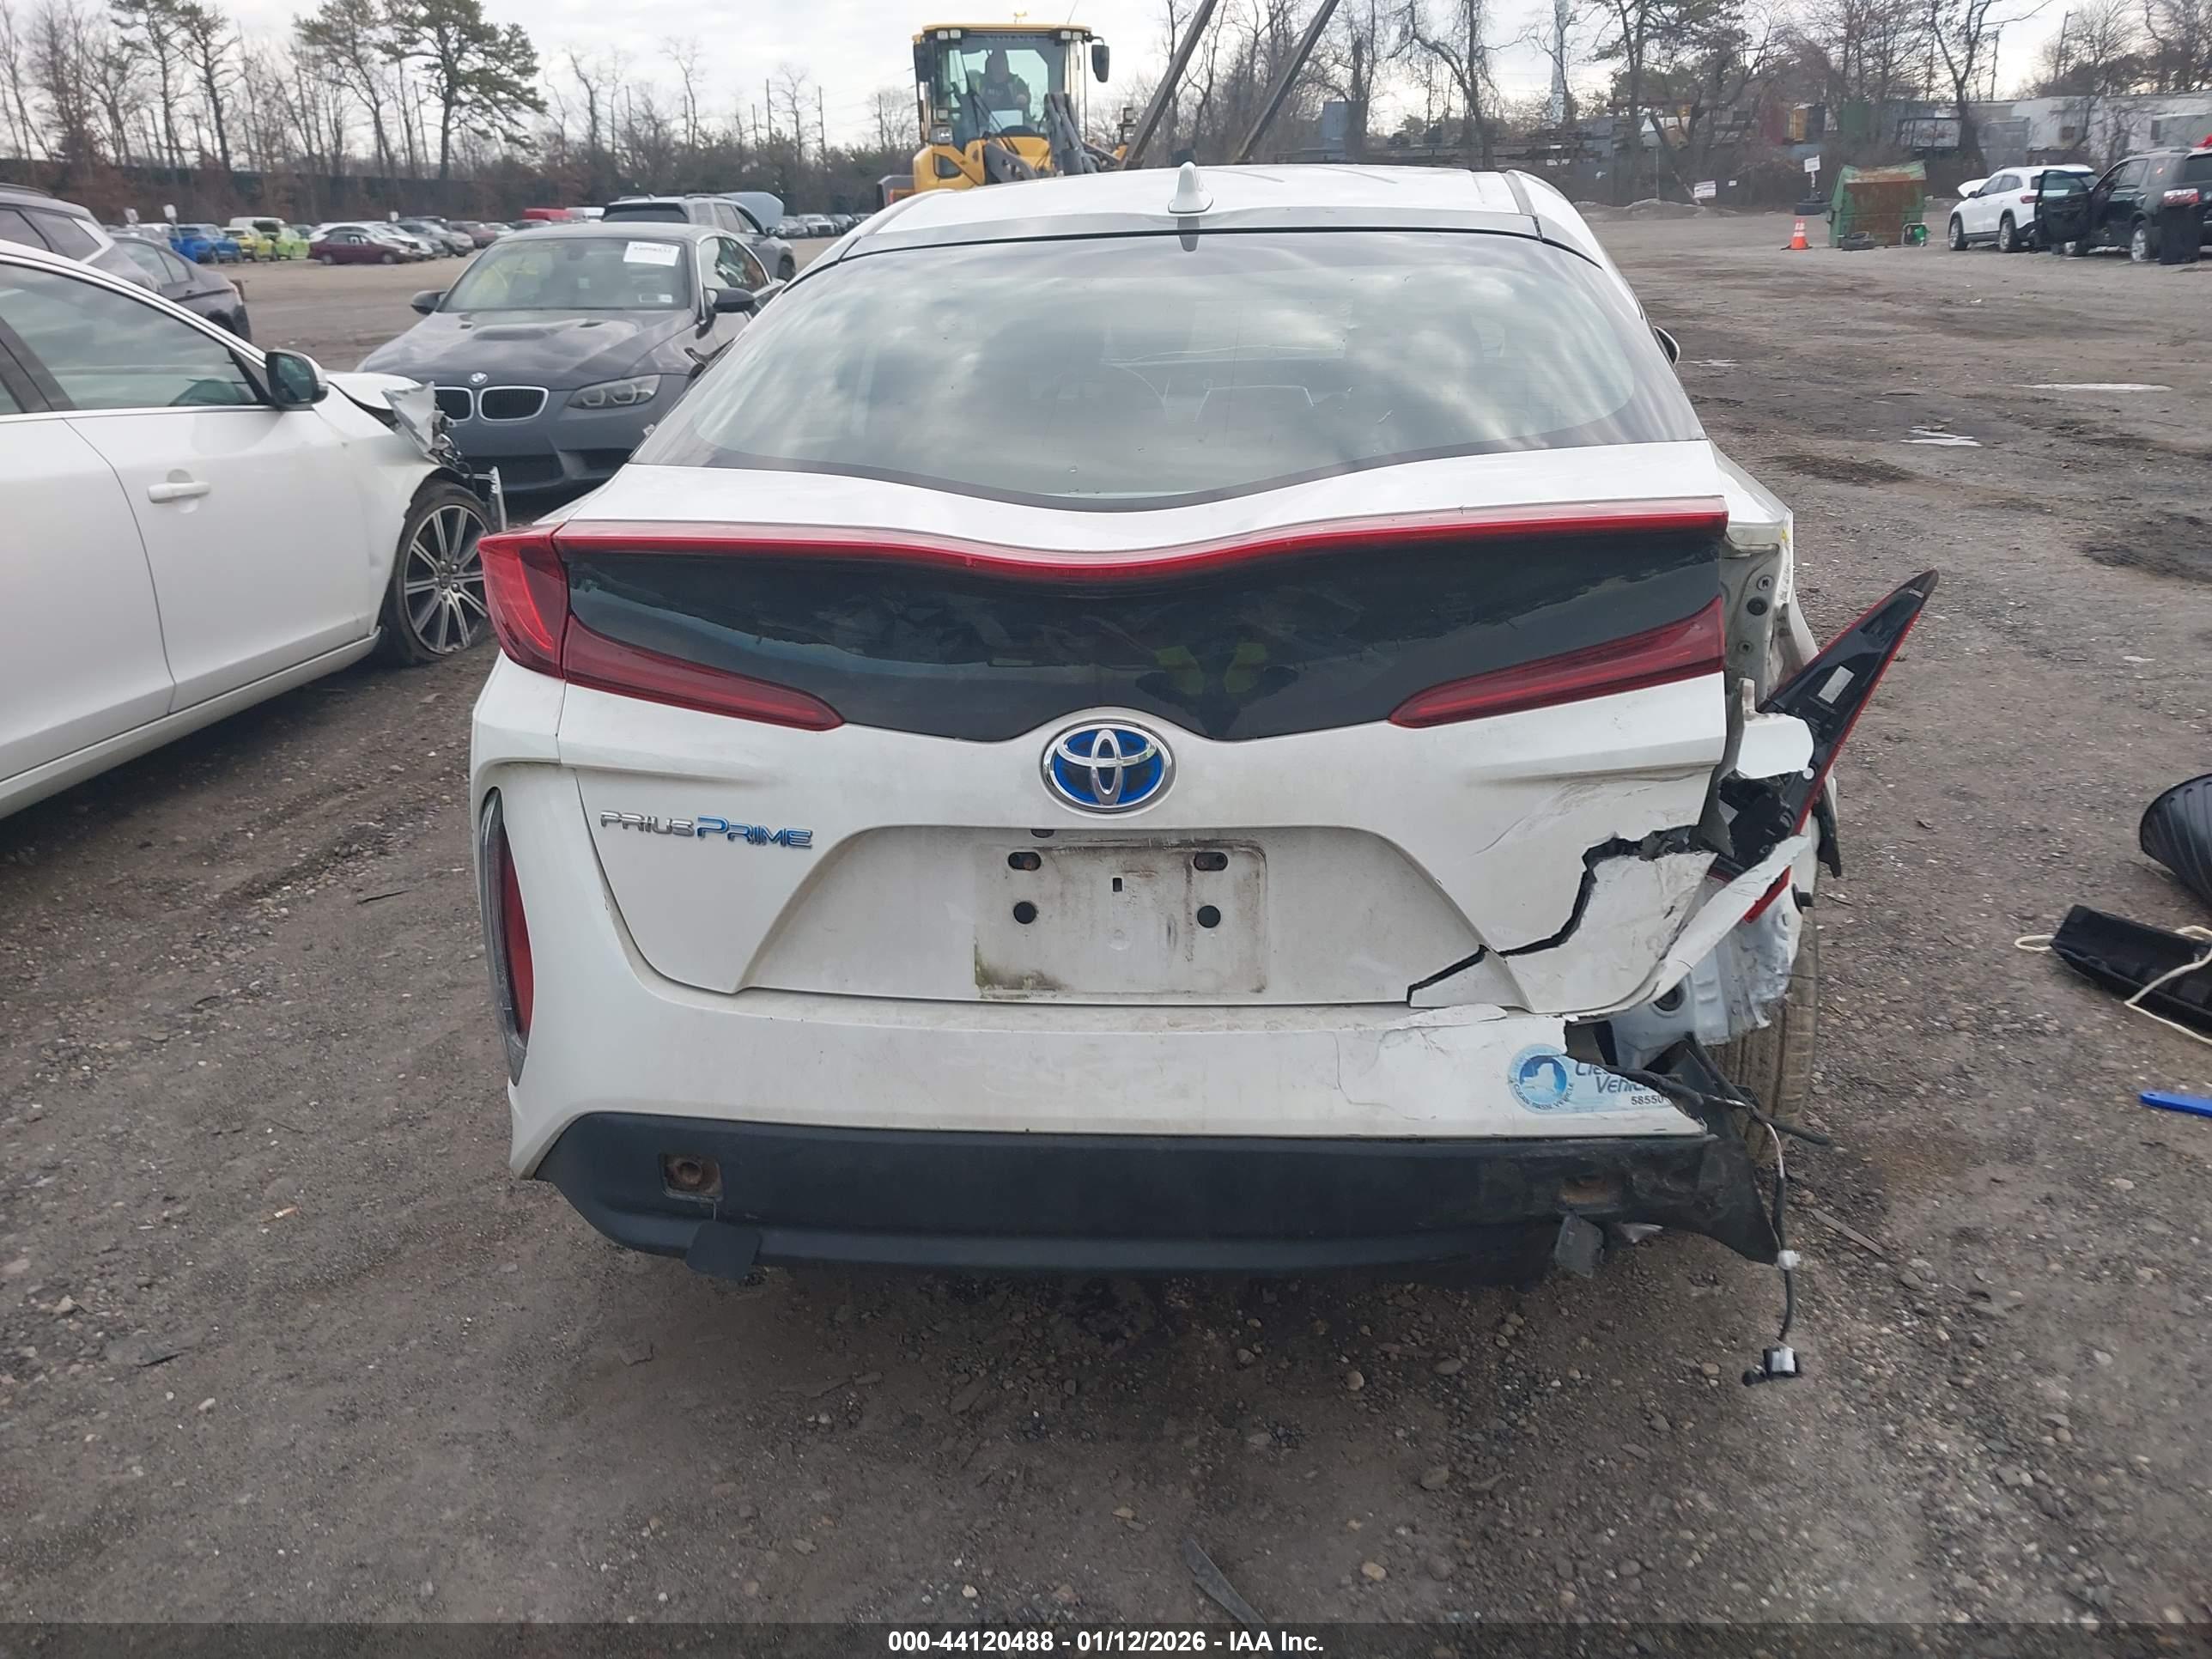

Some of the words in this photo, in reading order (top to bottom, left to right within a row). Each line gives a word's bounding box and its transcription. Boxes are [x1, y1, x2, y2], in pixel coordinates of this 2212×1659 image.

[600, 811, 694, 837] PRIUS
[696, 817, 813, 848] PRIME
[1575, 1061, 1608, 1076] Cle
[1596, 1075, 1646, 1094] Vehic
